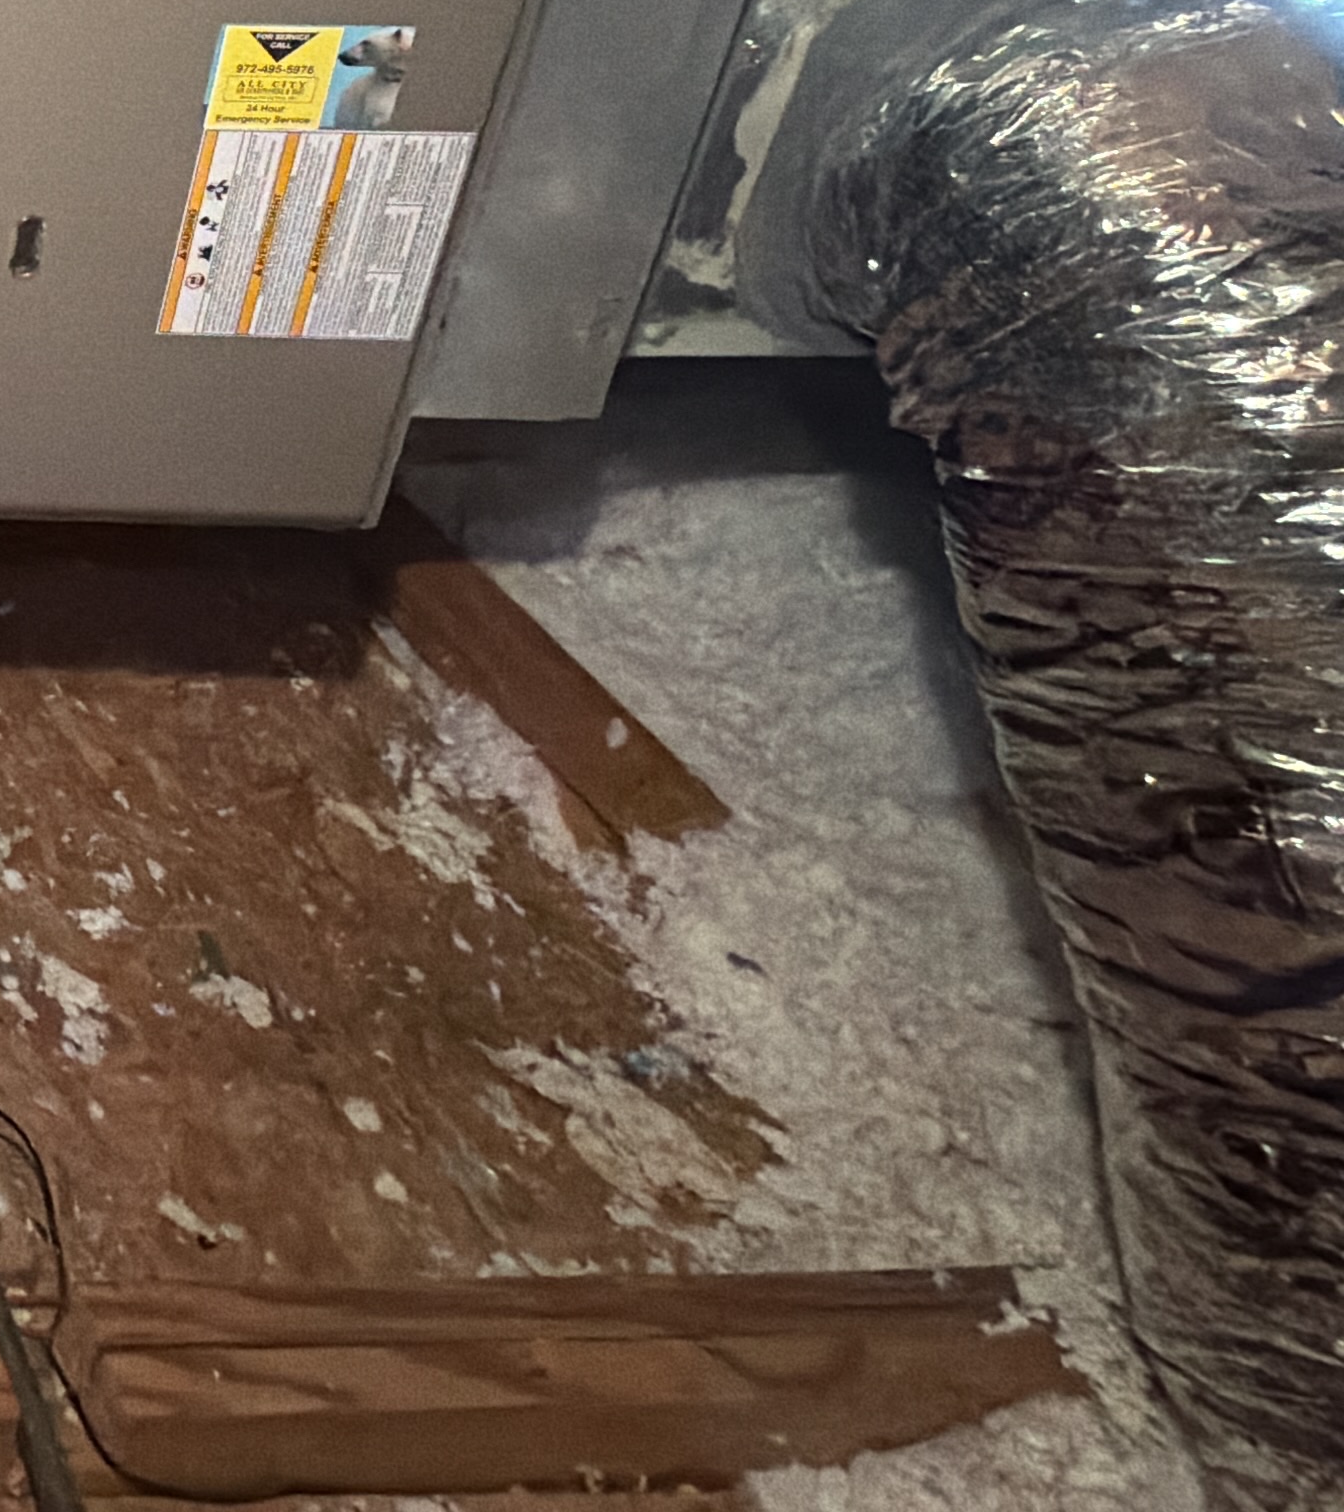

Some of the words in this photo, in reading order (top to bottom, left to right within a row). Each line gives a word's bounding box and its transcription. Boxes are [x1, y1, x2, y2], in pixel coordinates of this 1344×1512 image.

[237, 80, 264, 88] ALL
[271, 80, 306, 88] CITY
[260, 104, 285, 112] Hour
[215, 114, 272, 124] Emergency
[273, 115, 311, 123] Service
